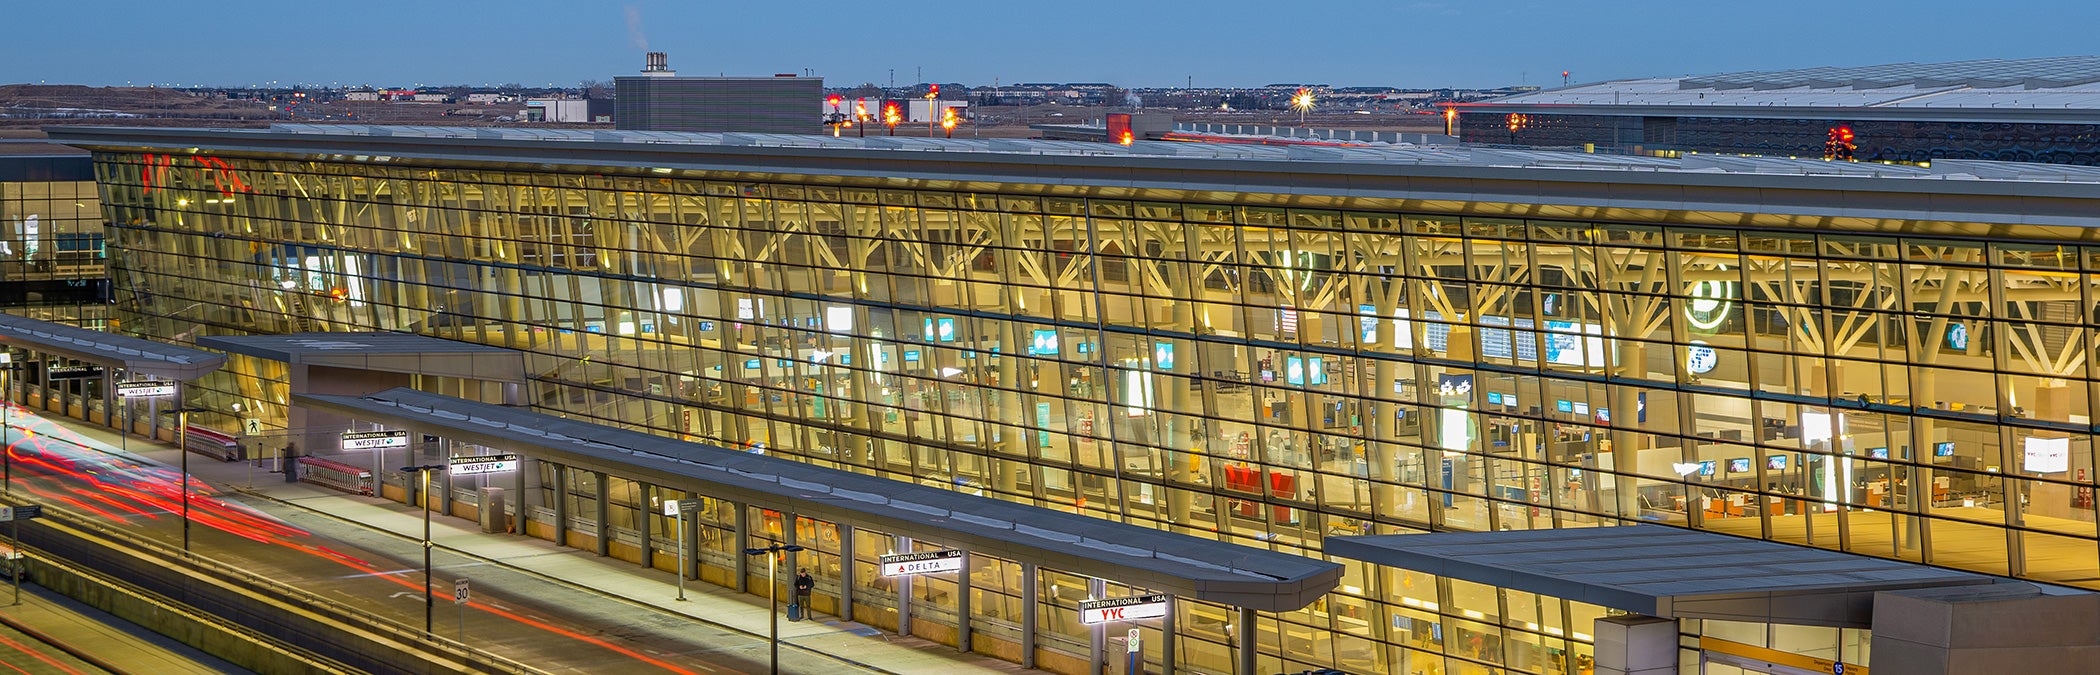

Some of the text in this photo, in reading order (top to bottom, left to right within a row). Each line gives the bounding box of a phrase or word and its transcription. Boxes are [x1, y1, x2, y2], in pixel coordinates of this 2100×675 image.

[355, 439, 385, 447] WESTJET
[463, 463, 495, 472] WESTJET
[884, 553, 939, 563] INTERNATIONAL
[908, 562, 940, 571] DELTA
[456, 587, 468, 600] 30
[1085, 598, 1142, 609] INTERNATIONAL
[1101, 607, 1125, 620] YYC
[1834, 664, 1843, 674] 15
